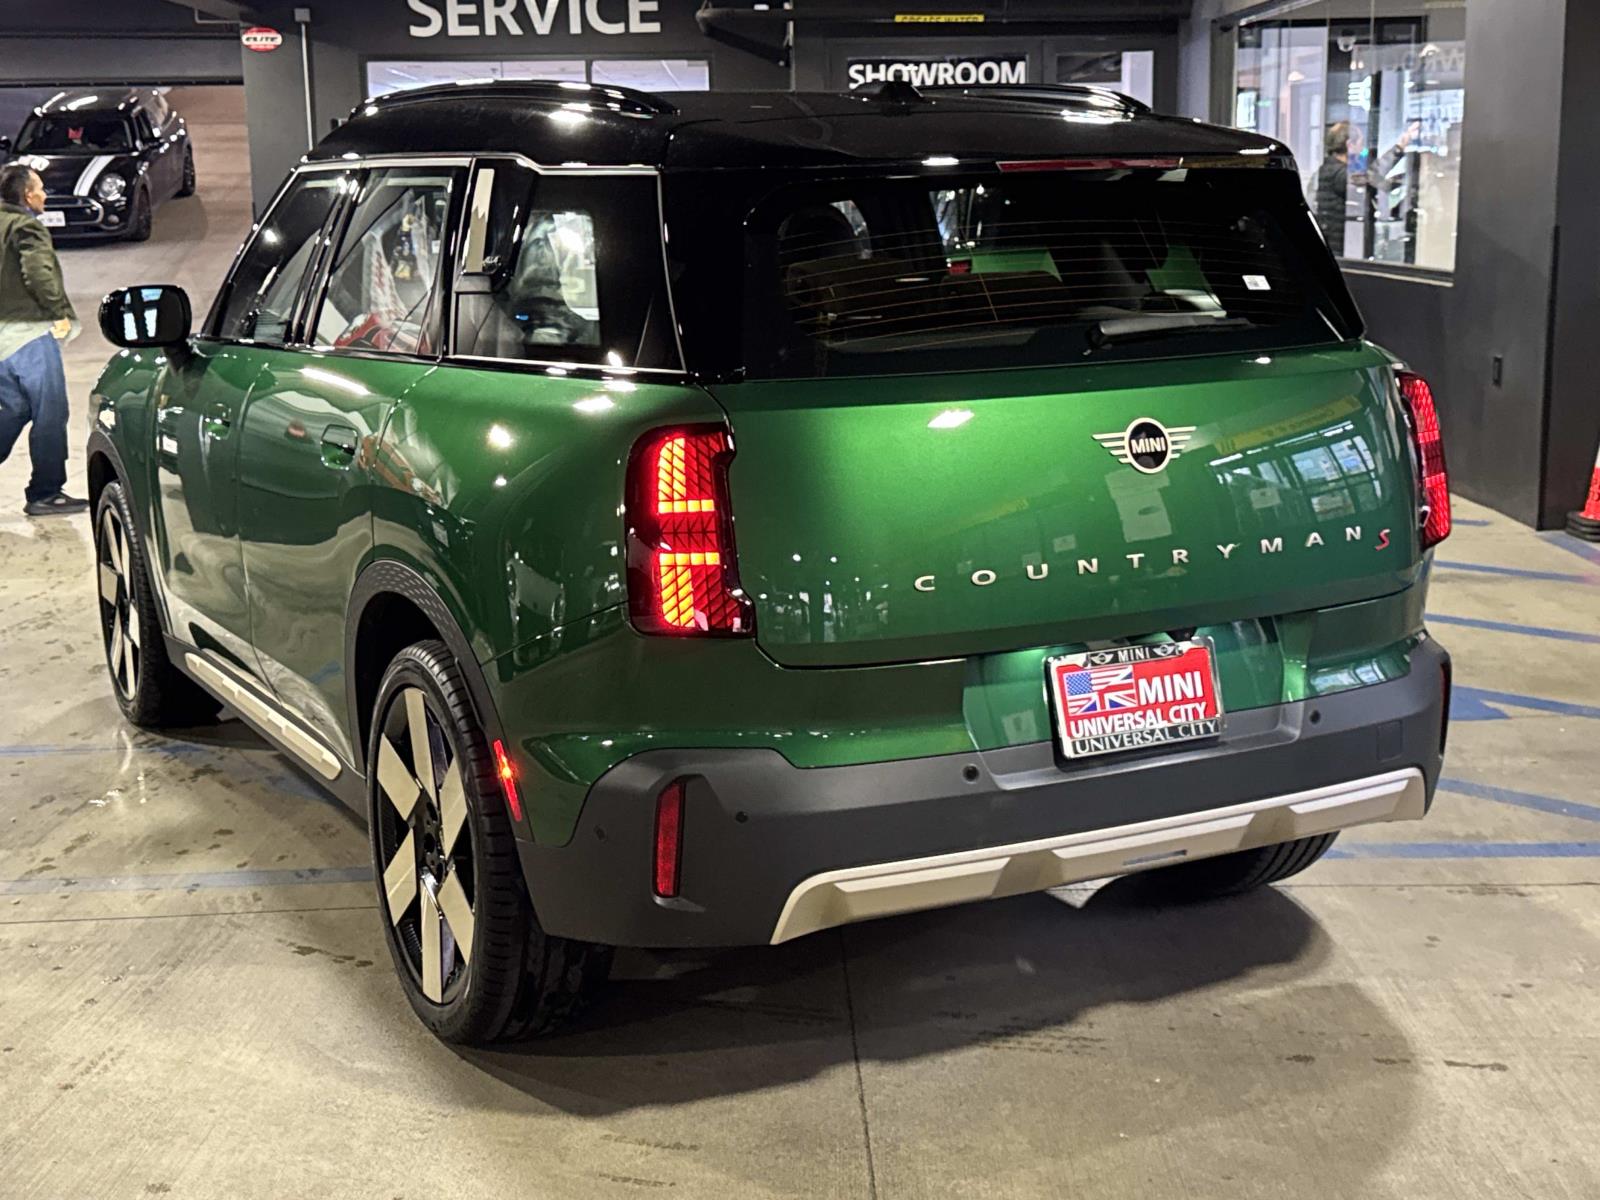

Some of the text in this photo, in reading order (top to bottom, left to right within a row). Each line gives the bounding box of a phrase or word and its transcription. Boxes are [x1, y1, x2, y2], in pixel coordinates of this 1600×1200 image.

[408, 0, 661, 37] SERVICE
[849, 61, 1026, 89] SHOWROOM
[1131, 437, 1166, 454] MINI
[914, 526, 1391, 592] COUNTRYMAN S
[1118, 647, 1150, 663] MINI
[1138, 670, 1204, 706] MINI
[1070, 701, 1208, 739] UNIVERSAL CITY
[1076, 720, 1217, 753] UNIVERSAL CITY
